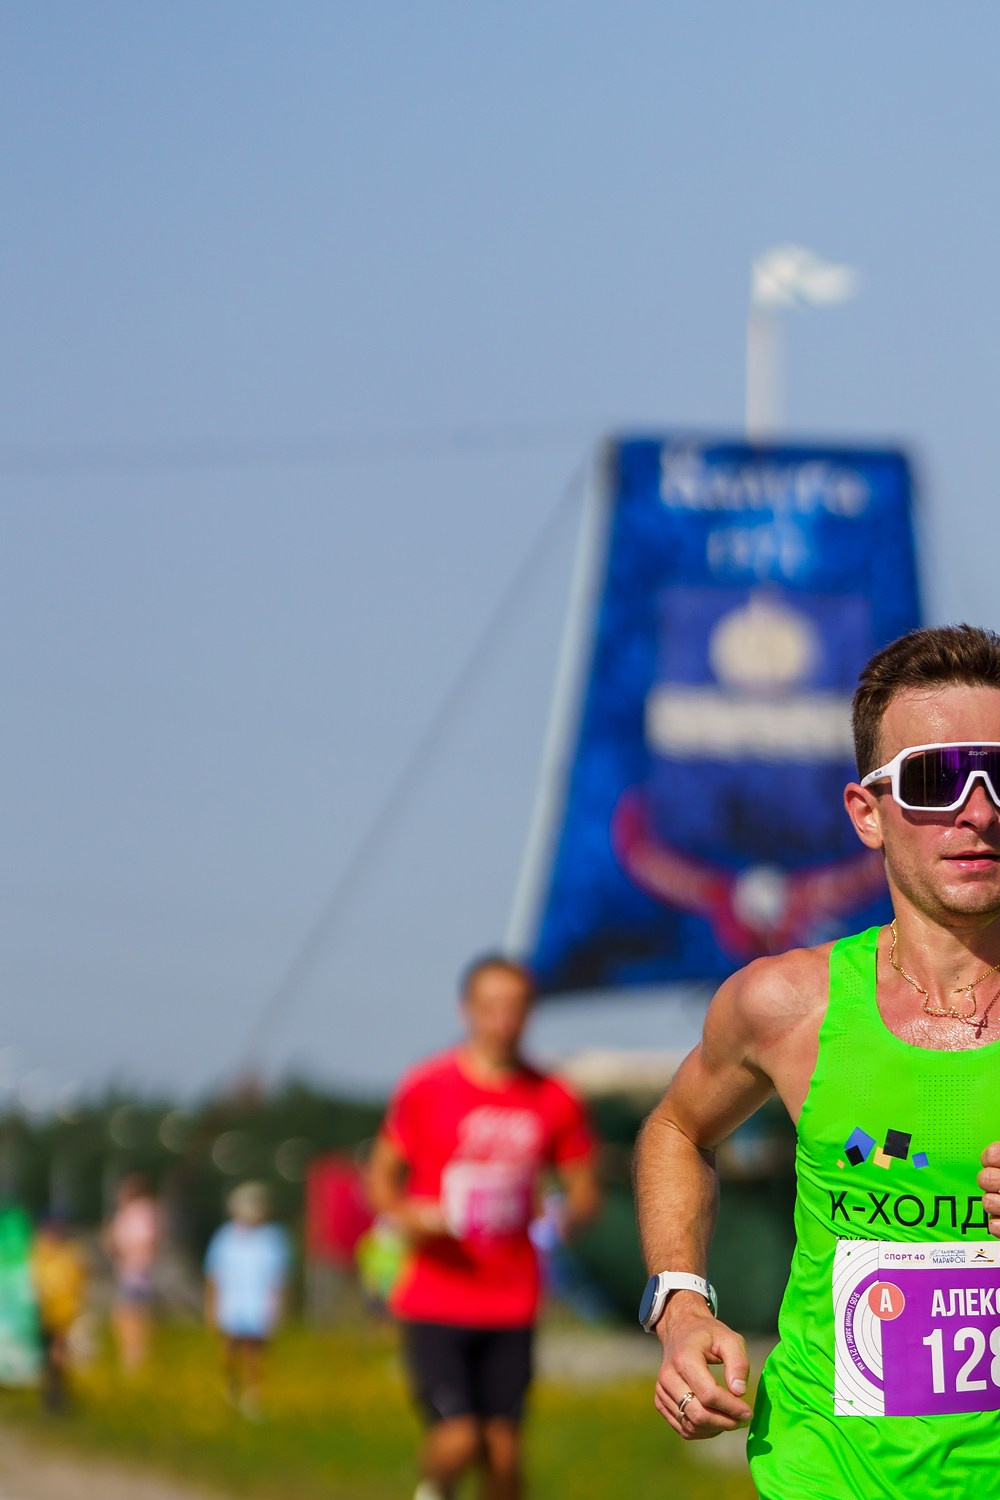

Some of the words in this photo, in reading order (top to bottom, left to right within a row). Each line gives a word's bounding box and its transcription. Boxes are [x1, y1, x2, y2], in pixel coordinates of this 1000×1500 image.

[828, 1190, 989, 1235] К-ХОЛД
[884, 1253, 913, 1261] СПОРТ
[914, 1253, 926, 1261] 40
[932, 1256, 966, 1264] МАРАФОН
